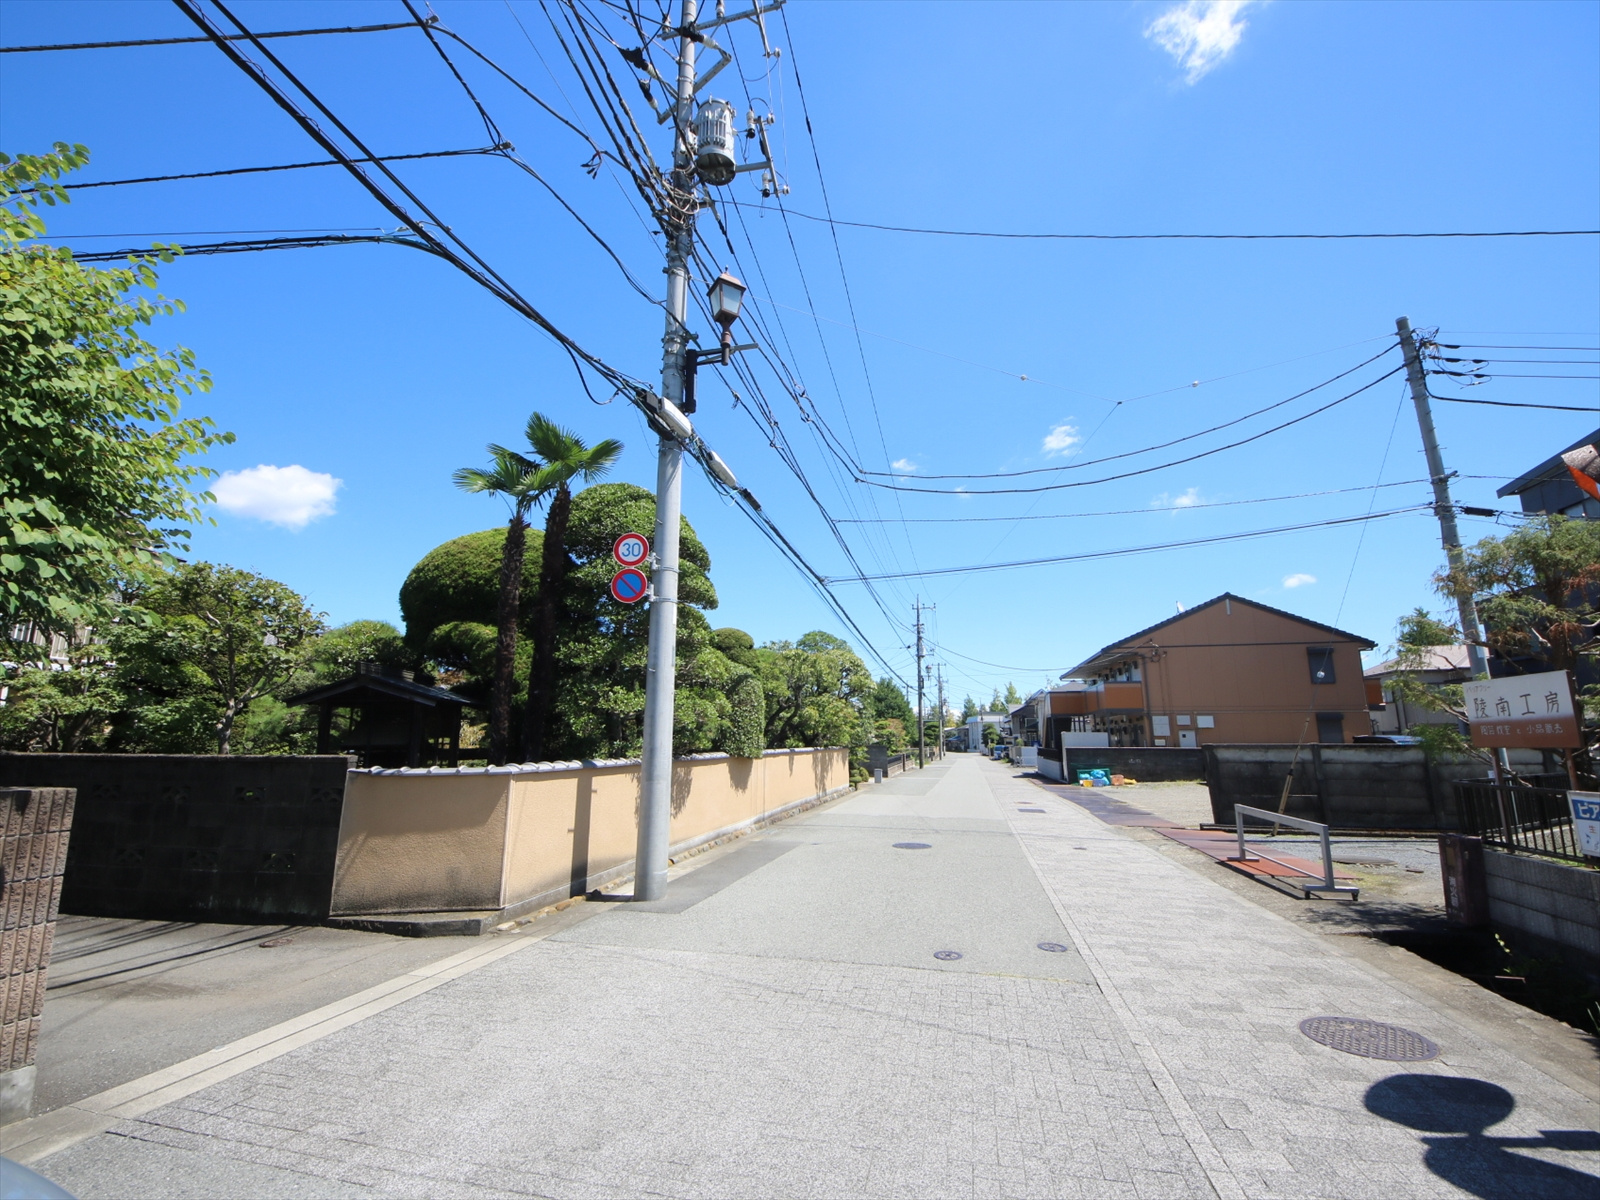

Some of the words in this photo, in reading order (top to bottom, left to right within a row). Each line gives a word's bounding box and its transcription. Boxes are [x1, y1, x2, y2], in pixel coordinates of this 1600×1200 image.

[621, 542, 642, 557] 30
[1473, 690, 1560, 719] 陵南工房
[1577, 801, 1600, 819] ピア
